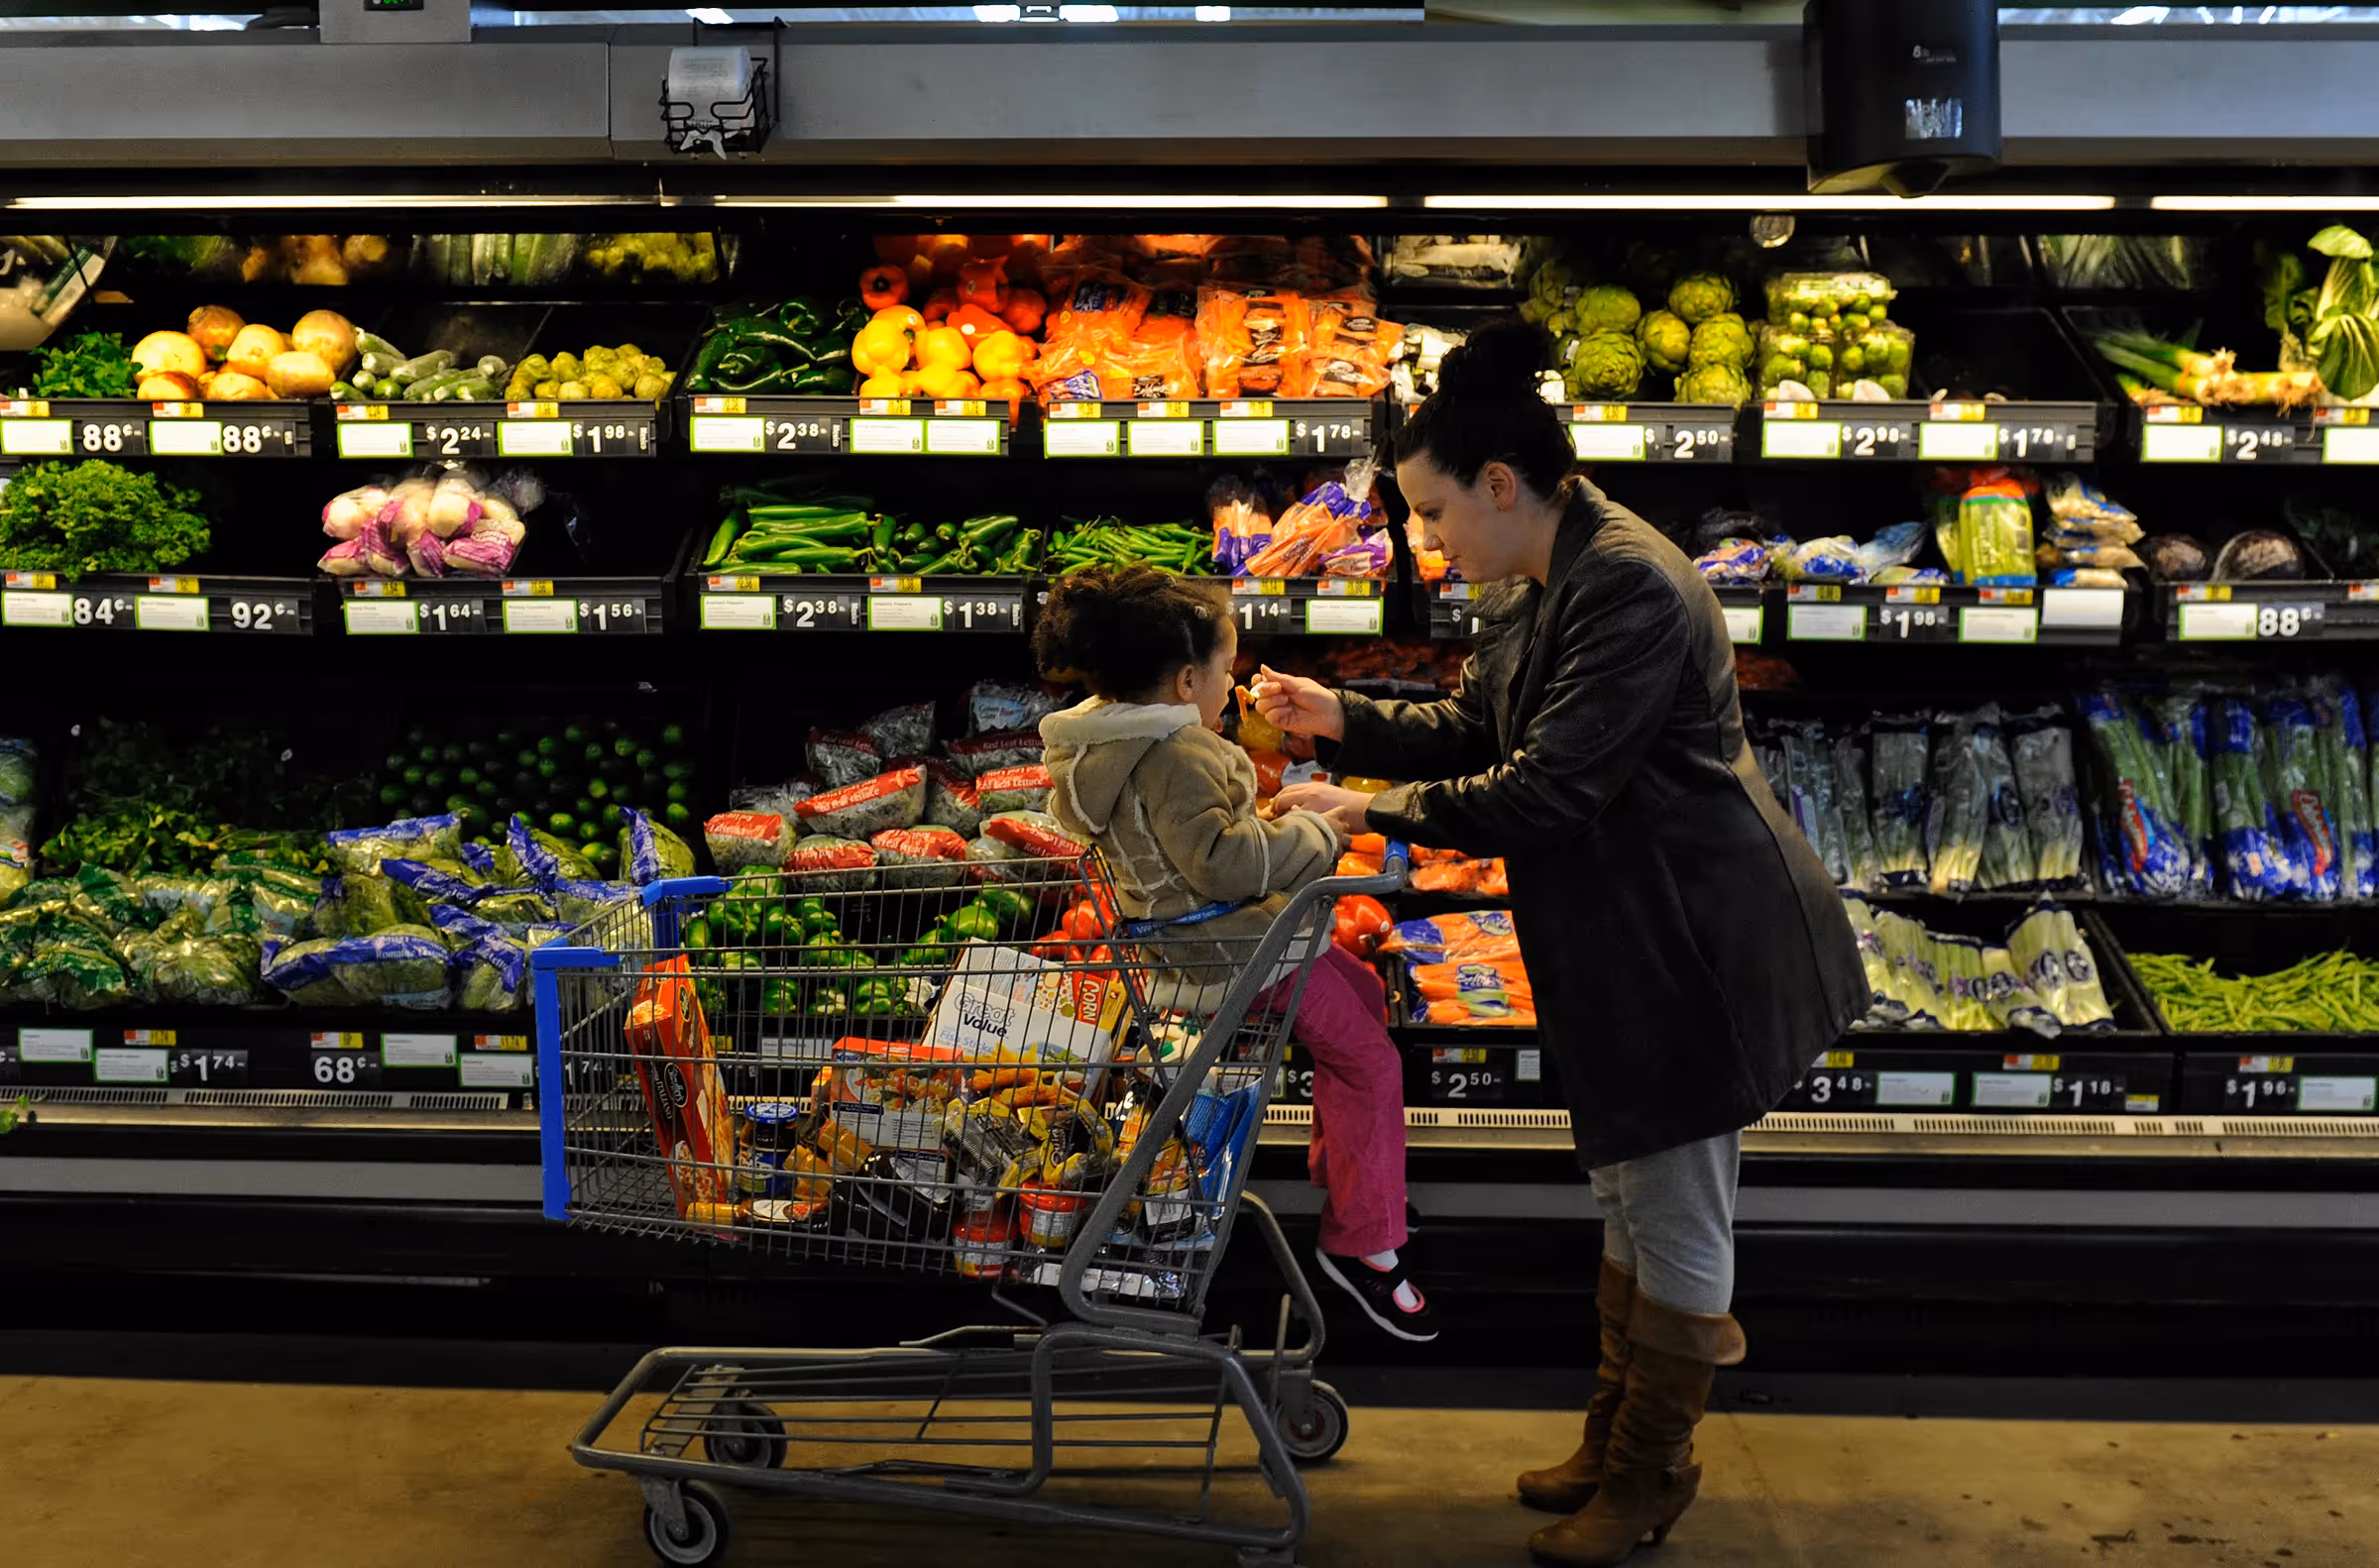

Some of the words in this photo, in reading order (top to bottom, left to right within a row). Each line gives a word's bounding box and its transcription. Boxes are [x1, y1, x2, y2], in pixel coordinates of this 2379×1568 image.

[832, 424, 841, 448] Mexico
[1011, 603, 1021, 626] Mexico
[955, 992, 1016, 1027] Great
[1078, 979, 1100, 1022] CORN
[963, 1013, 1008, 1038] Value
[656, 1080, 673, 1119] ITALIANO
